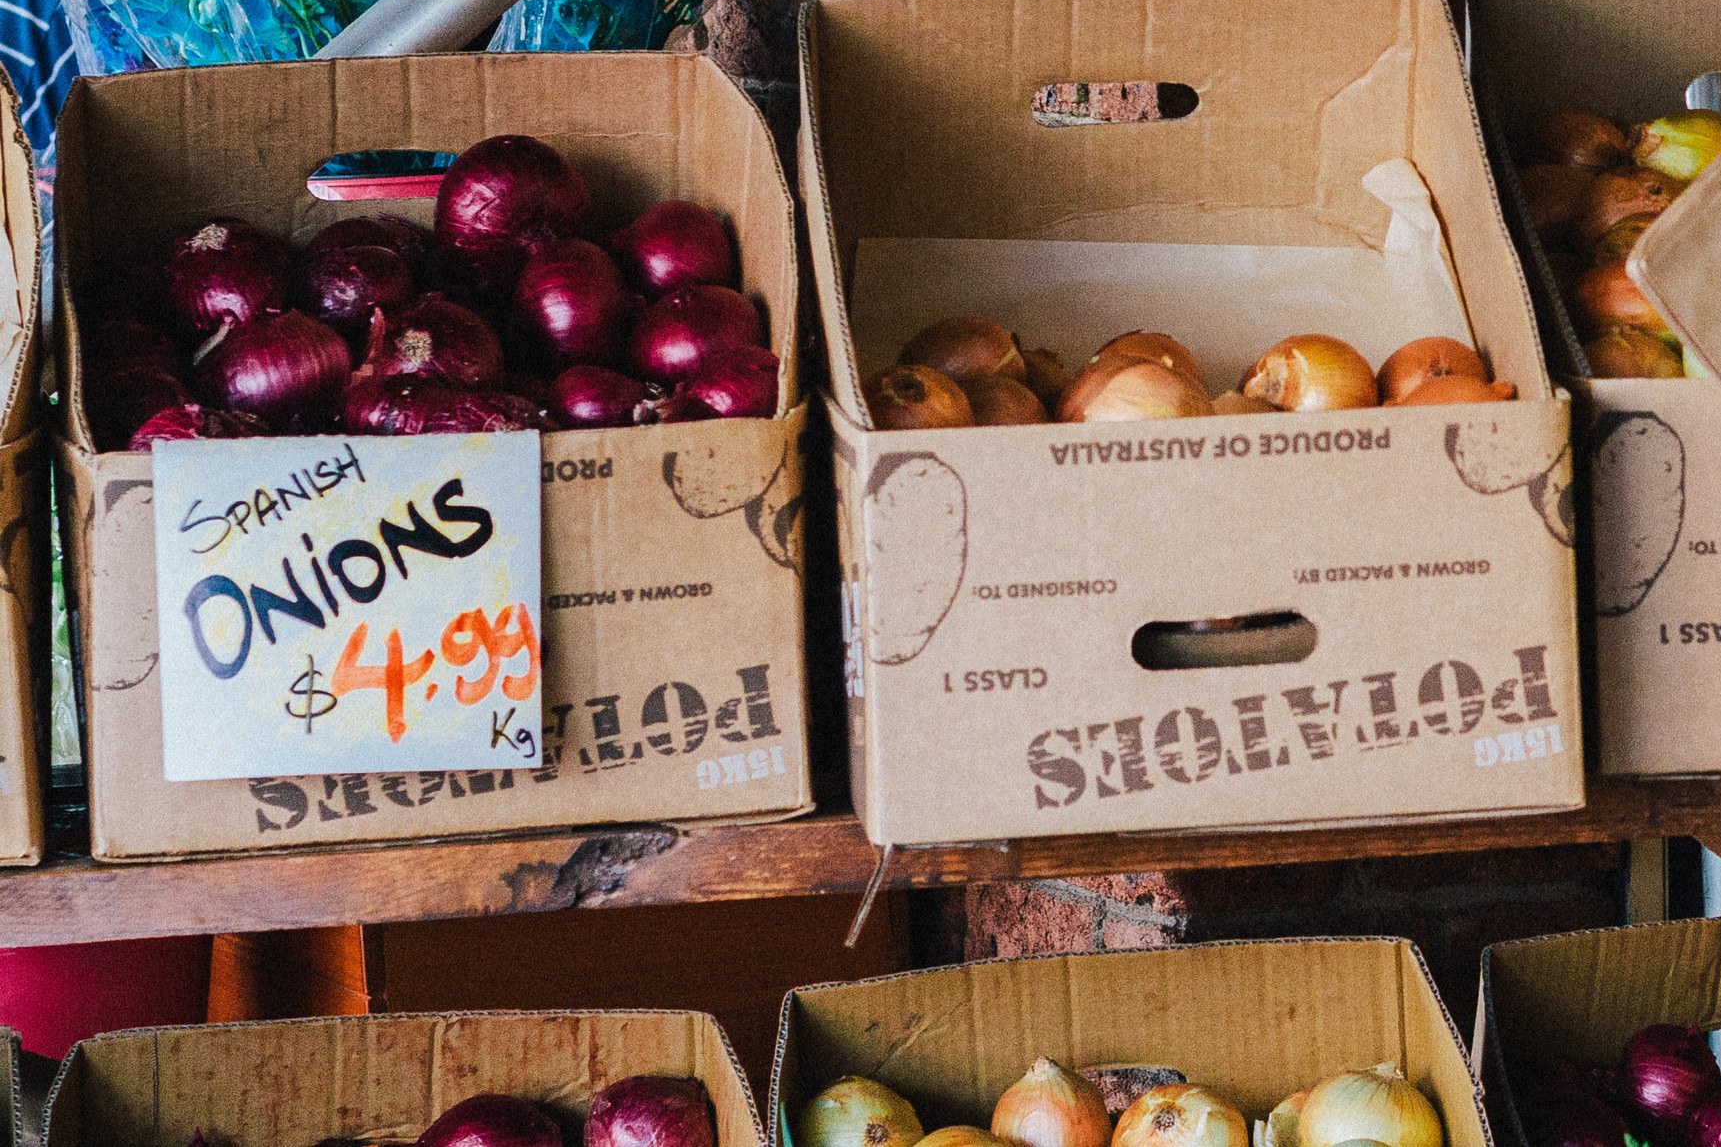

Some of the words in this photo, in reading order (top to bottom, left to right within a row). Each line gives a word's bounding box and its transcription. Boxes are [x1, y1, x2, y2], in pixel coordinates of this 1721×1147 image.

[1050, 436, 1205, 466] AUSTRALIA
[1212, 433, 1251, 459] OF
[1259, 427, 1392, 456] PRODUCE
[542, 457, 613, 484] PROD
[179, 441, 366, 554] SPANISH
[1687, 539, 1719, 556] TO:
[1293, 567, 1321, 585] BY:
[1325, 565, 1394, 582] PACKED
[1398, 563, 1412, 578] &
[1416, 559, 1492, 578] GROWN
[550, 590, 617, 610] PACKED
[621, 588, 635, 602] &
[639, 582, 714, 602] GROWN
[972, 584, 1002, 600] TO:
[1006, 579, 1118, 599] CONSIGNED
[1658, 621, 1669, 646] 1
[943, 672, 954, 694] 1
[963, 666, 1049, 693] CLASS
[491, 706, 536, 758] Kg
[1026, 644, 1560, 811] POTATOES
[1472, 722, 1566, 769] 15KG
[694, 745, 787, 791] 15KG
